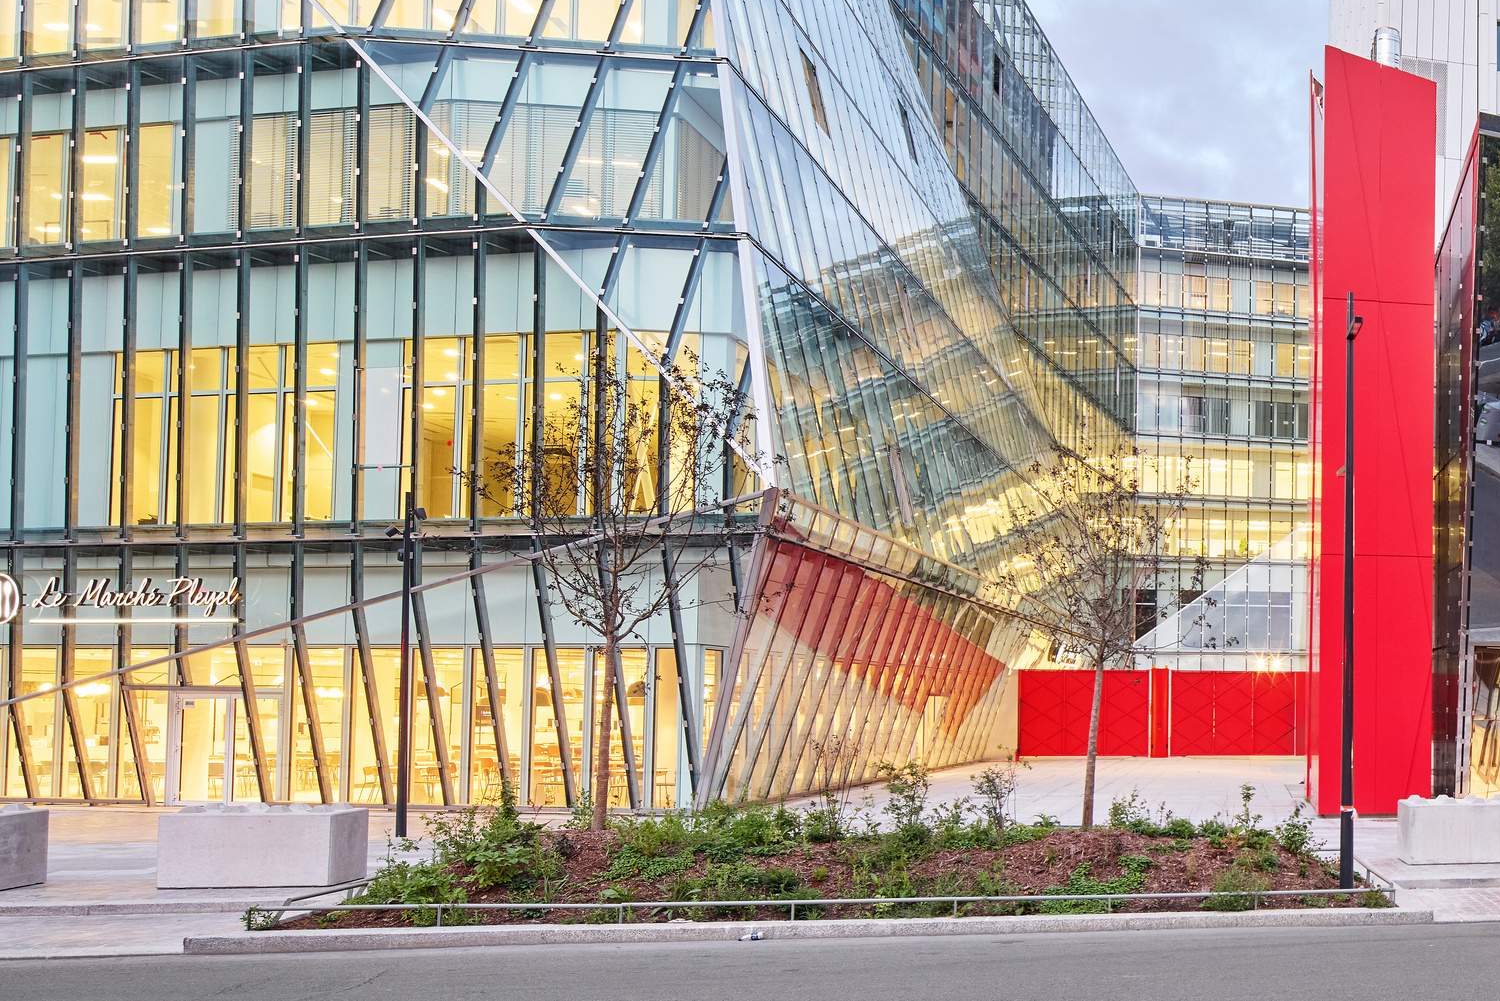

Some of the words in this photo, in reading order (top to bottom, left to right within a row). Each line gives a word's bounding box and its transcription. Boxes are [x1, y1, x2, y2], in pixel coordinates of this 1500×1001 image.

[32, 577, 68, 609] Le
[73, 577, 162, 609] Marché
[166, 576, 241, 617] Pleyel
